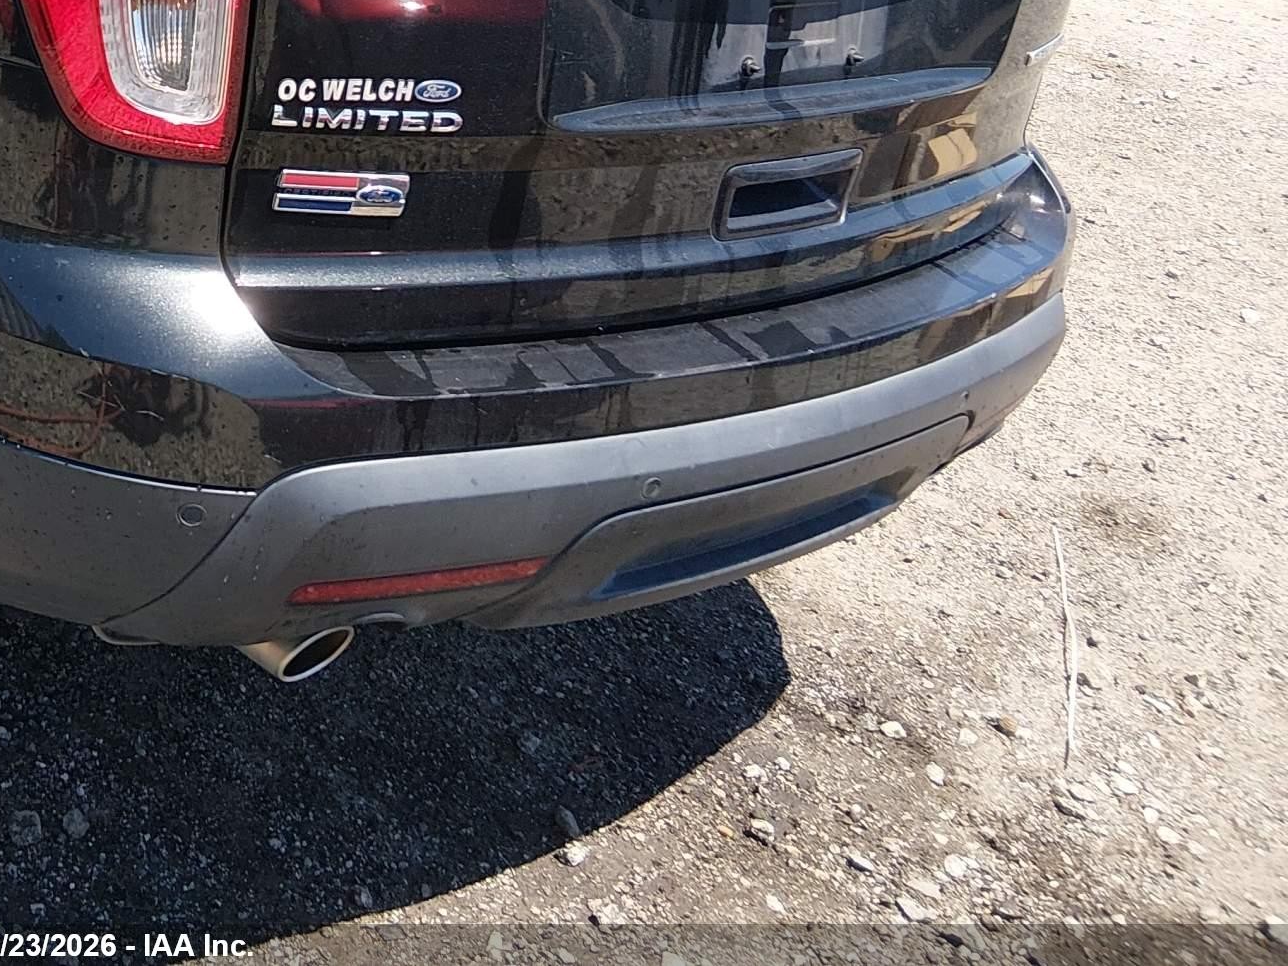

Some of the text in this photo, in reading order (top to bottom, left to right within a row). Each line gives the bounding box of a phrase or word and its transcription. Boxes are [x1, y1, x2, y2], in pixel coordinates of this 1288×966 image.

[277, 78, 454, 102] OC WELCH Ford
[271, 104, 464, 133] LIMITED
